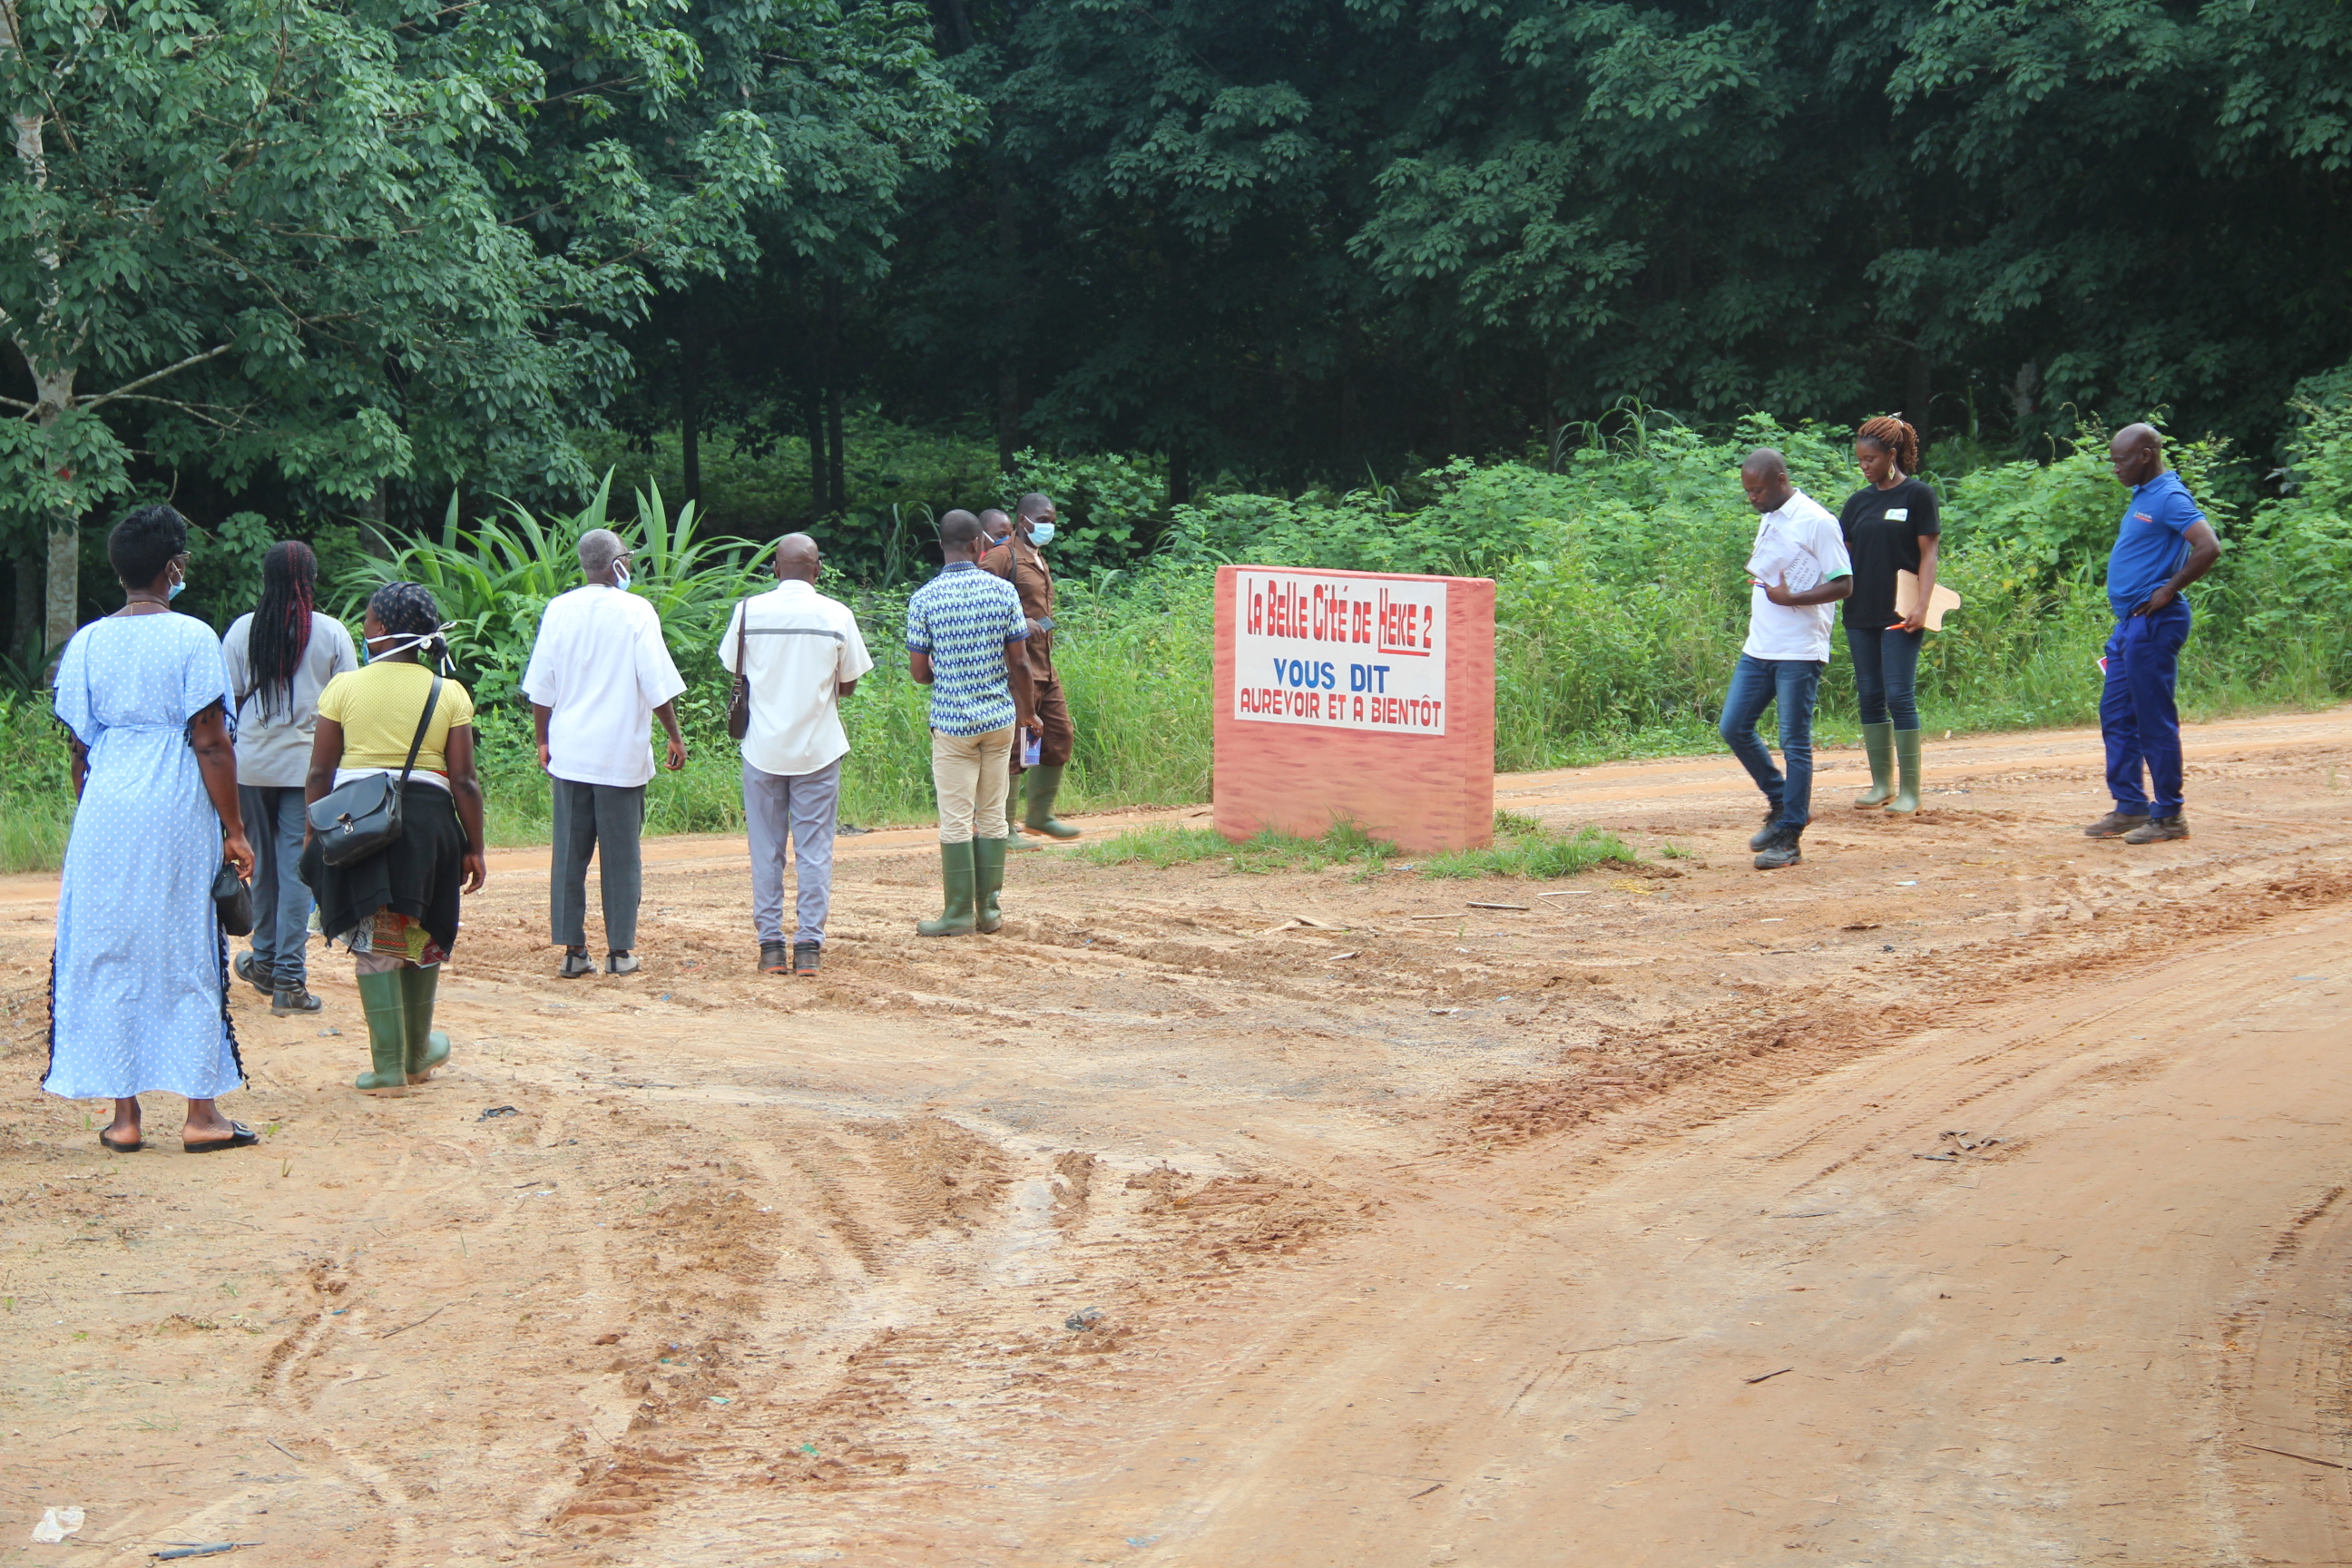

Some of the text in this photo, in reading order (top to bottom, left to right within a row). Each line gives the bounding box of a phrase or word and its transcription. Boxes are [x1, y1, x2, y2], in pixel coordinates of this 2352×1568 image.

[1352, 601, 1371, 644] DE
[1377, 588, 1416, 650] HEKE
[1423, 605, 1433, 649] 2
[1273, 658, 1390, 693] VOUS DIT
[1240, 688, 1441, 728] AUREVOIR ET A BIENTÔT
